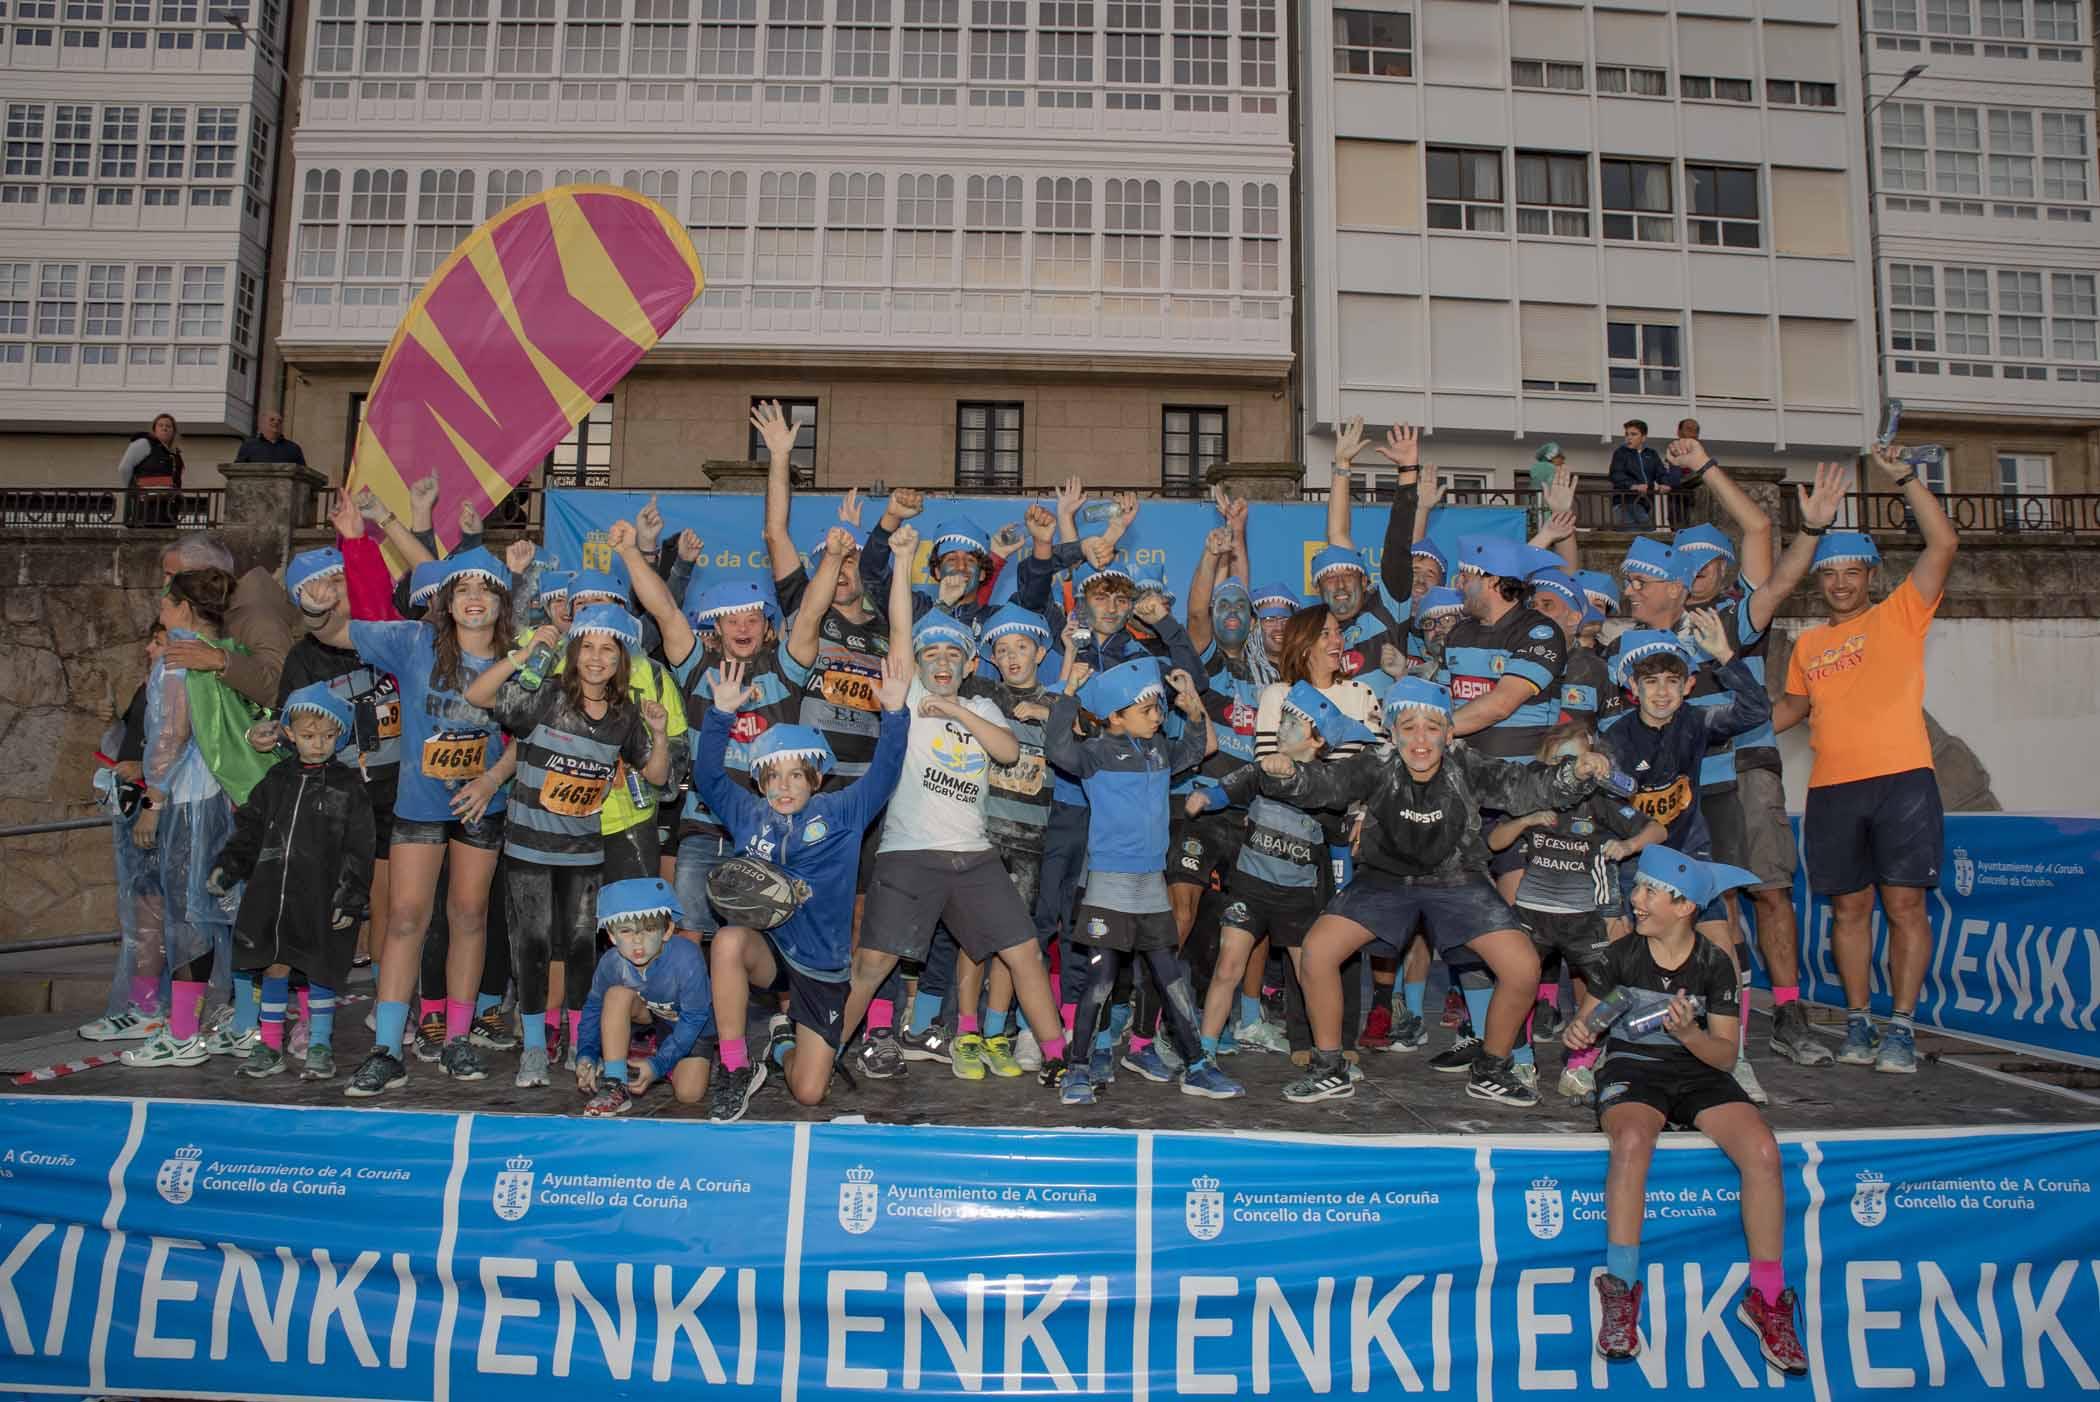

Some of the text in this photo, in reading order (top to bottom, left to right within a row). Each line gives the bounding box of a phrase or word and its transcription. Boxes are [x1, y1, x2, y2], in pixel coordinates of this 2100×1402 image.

[715, 549, 741, 568] da
[1136, 547, 1166, 565] en
[429, 746, 483, 769] 14654
[922, 780, 955, 798] RUGBY
[923, 767, 980, 796] SUMMER
[1251, 830, 1312, 862] ABANCA
[1545, 838, 1590, 853] CESUGA
[1532, 855, 1585, 871] ABANCA
[1951, 918, 2100, 1032] ENKI
[3, 1149, 77, 1167] A Coruña
[207, 1160, 411, 1181] Ayuntamiento de A Coruña
[202, 1176, 347, 1196] Concello da Coruña
[542, 1172, 751, 1193] Ayuntamiento de A Coruña
[1896, 1177, 2091, 1194] Ayuntamiento de A Coruña
[540, 1190, 688, 1209] Concello da Coruña
[887, 1184, 1097, 1202] Ayuntamiento de A Coruña
[1233, 1191, 1440, 1207] Ayuntamiento de A Coruña
[1679, 1188, 1697, 1201] de
[1702, 1189, 1713, 1201] A
[1894, 1195, 2035, 1209] Concello da Coruña
[886, 1202, 951, 1217] Concello
[1232, 1208, 1381, 1222] Concello da Coruña
[1660, 1206, 1717, 1219] Coruña
[133, 1235, 418, 1369] ENKI
[476, 1256, 758, 1386] ENKI
[1844, 1259, 2100, 1391] ENK
[826, 1270, 1109, 1395] ENKI
[1176, 1274, 1455, 1395] ENKI
